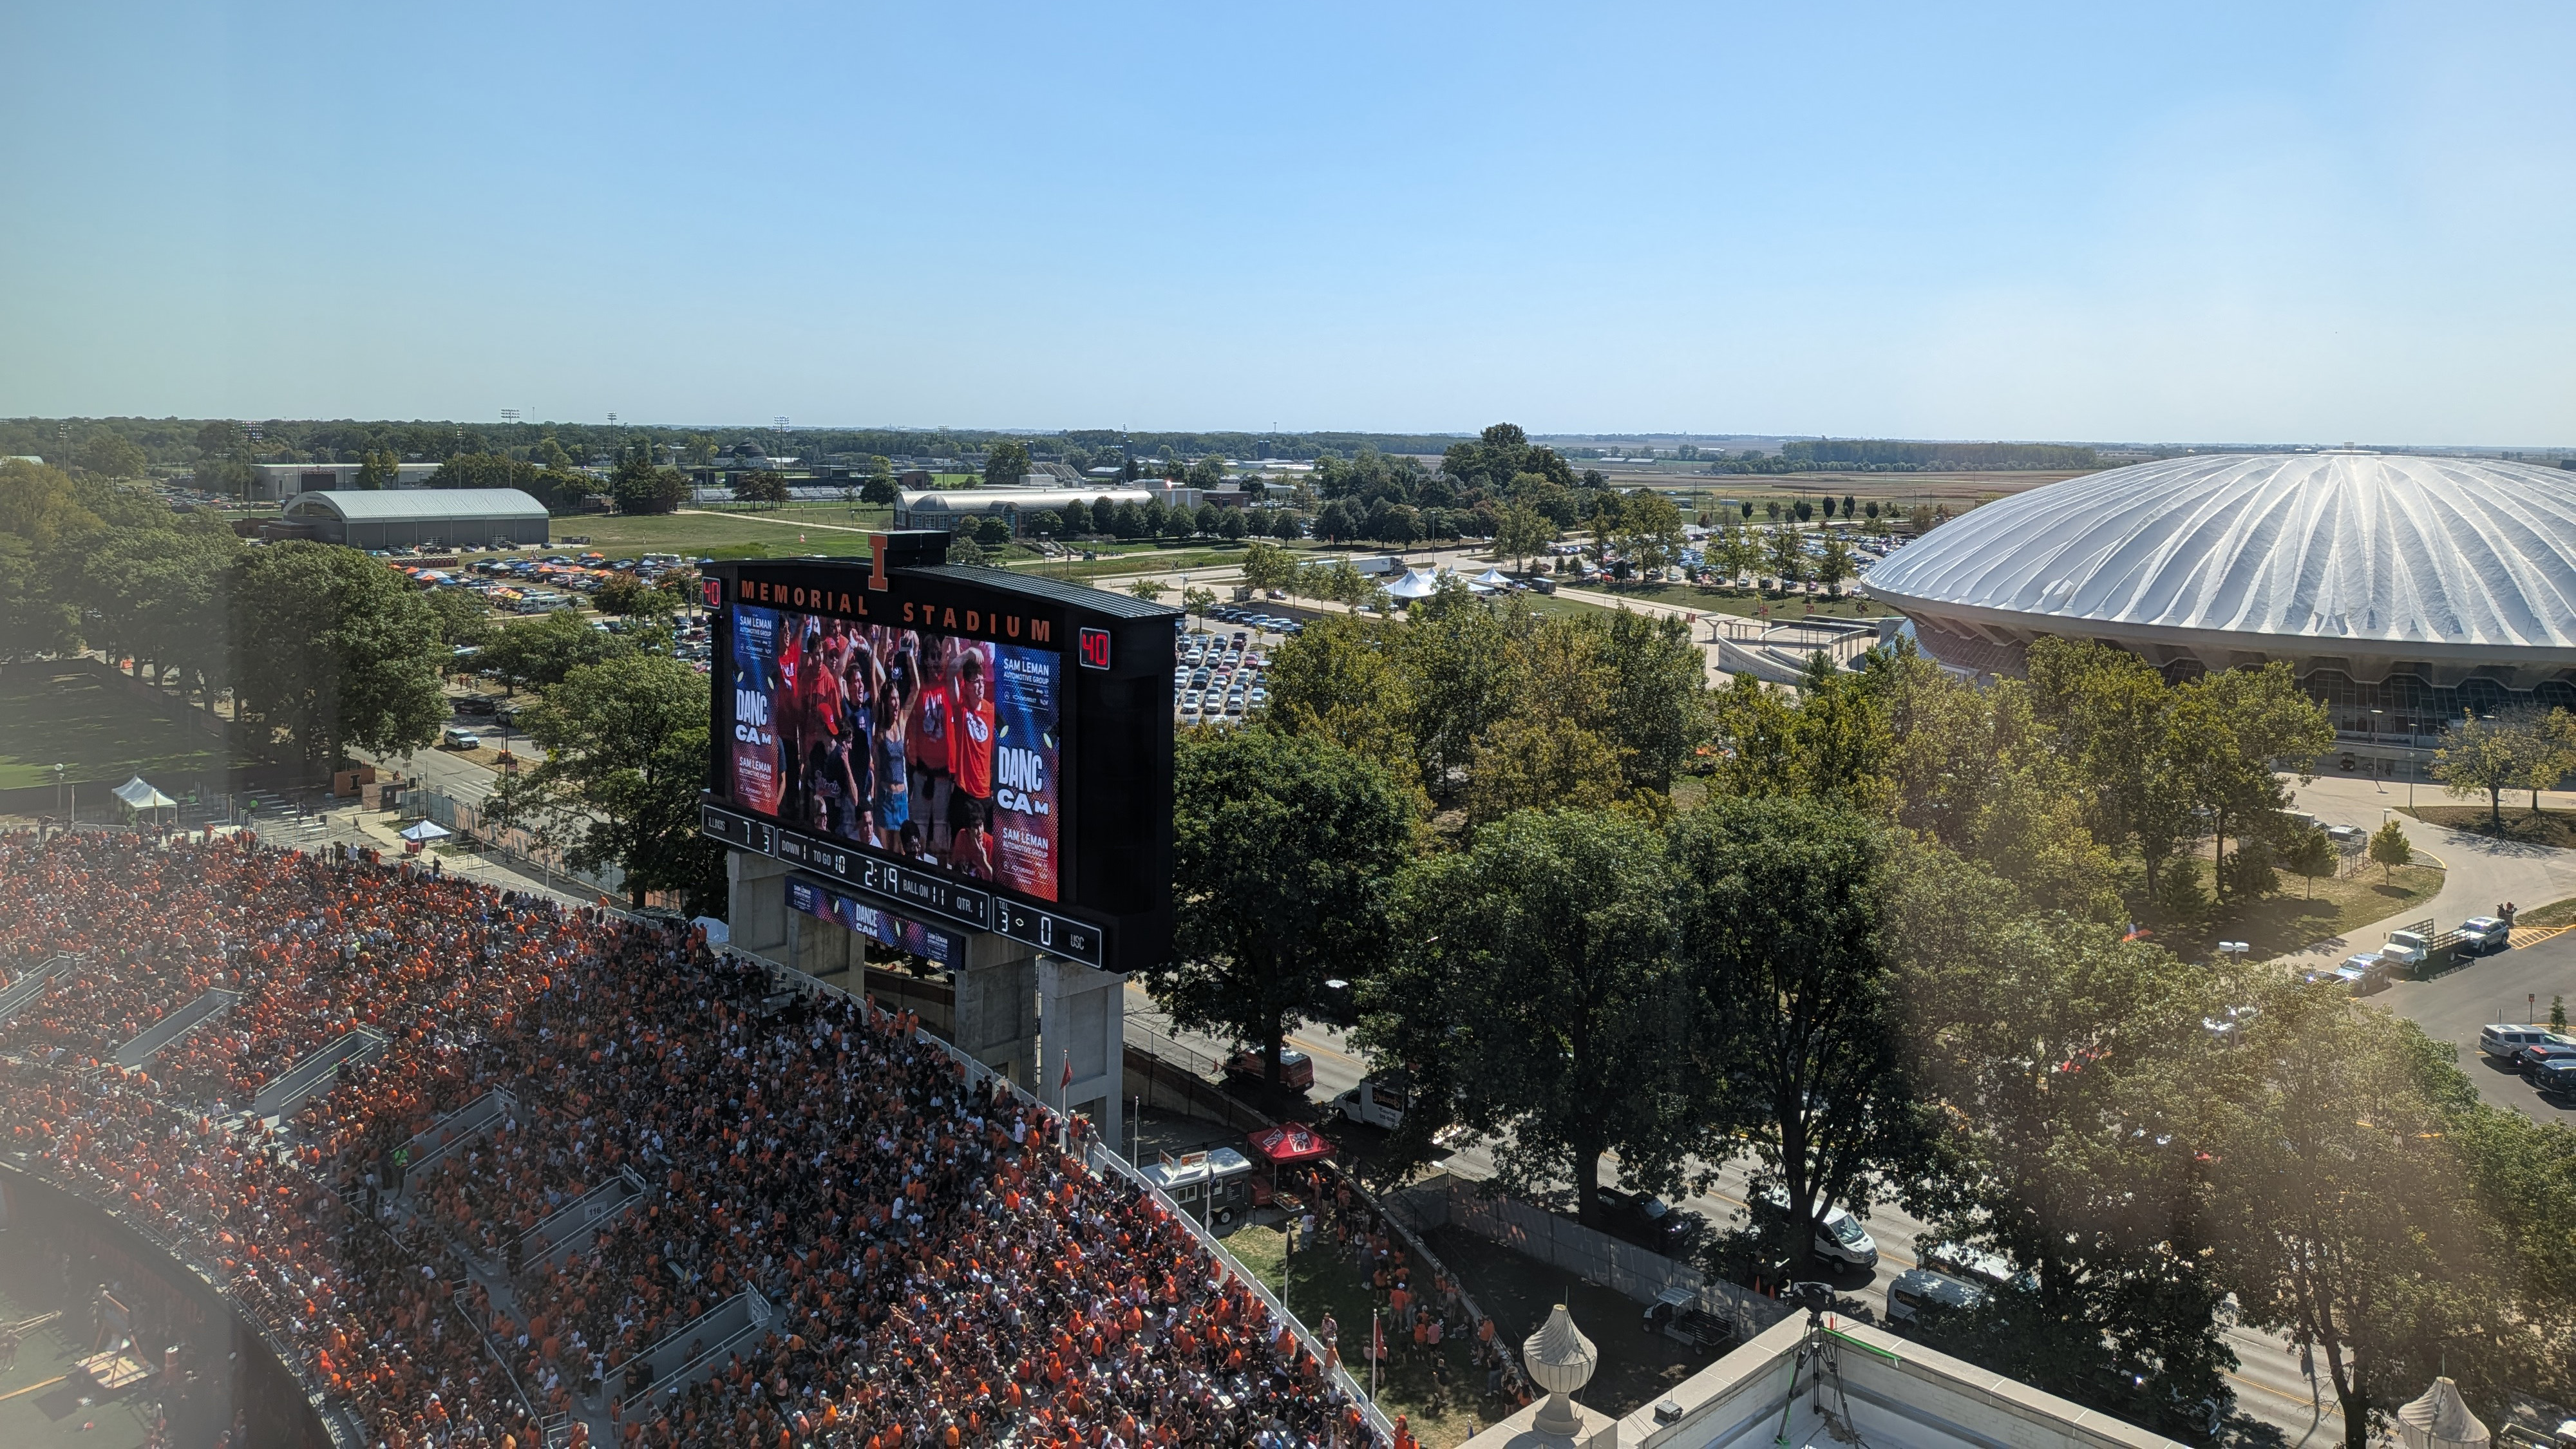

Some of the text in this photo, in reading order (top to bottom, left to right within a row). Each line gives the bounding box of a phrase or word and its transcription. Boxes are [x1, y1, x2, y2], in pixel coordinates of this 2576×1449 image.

[868, 534, 888, 592] I
[703, 582, 719, 605] 40
[741, 580, 1050, 642] MEMORIAL STADIUM
[740, 616, 772, 630] SAM LEMAN
[1083, 634, 1107, 665] 40
[1003, 658, 1049, 676] SAM LEMAN
[1004, 671, 1049, 685] AUTOMOTIVE GROUP
[736, 688, 767, 726] DANC
[739, 756, 772, 773] SAM LEMAN
[999, 746, 1043, 793] DANC
[743, 821, 750, 844] 7
[1003, 828, 1048, 850] SAM LEMAN
[764, 835, 770, 853] 3
[782, 840, 799, 856] DOWN
[804, 844, 806, 860] 1
[1003, 841, 1048, 858] AUTOMOTIVE GROUP
[813, 849, 831, 866] TO GO
[835, 855, 846, 874] 10
[865, 860, 898, 893] 2:19
[903, 879, 929, 898] BALL ON
[933, 886, 944, 905] 11
[956, 896, 973, 913] QTR.
[980, 902, 983, 918] 1
[856, 903, 878, 928] DANCE
[1001, 911, 1009, 932] 3
[856, 922, 878, 938] CAM
[1041, 916, 1051, 946] 0
[1070, 934, 1084, 951] USC
[589, 1206, 602, 1217] 116
